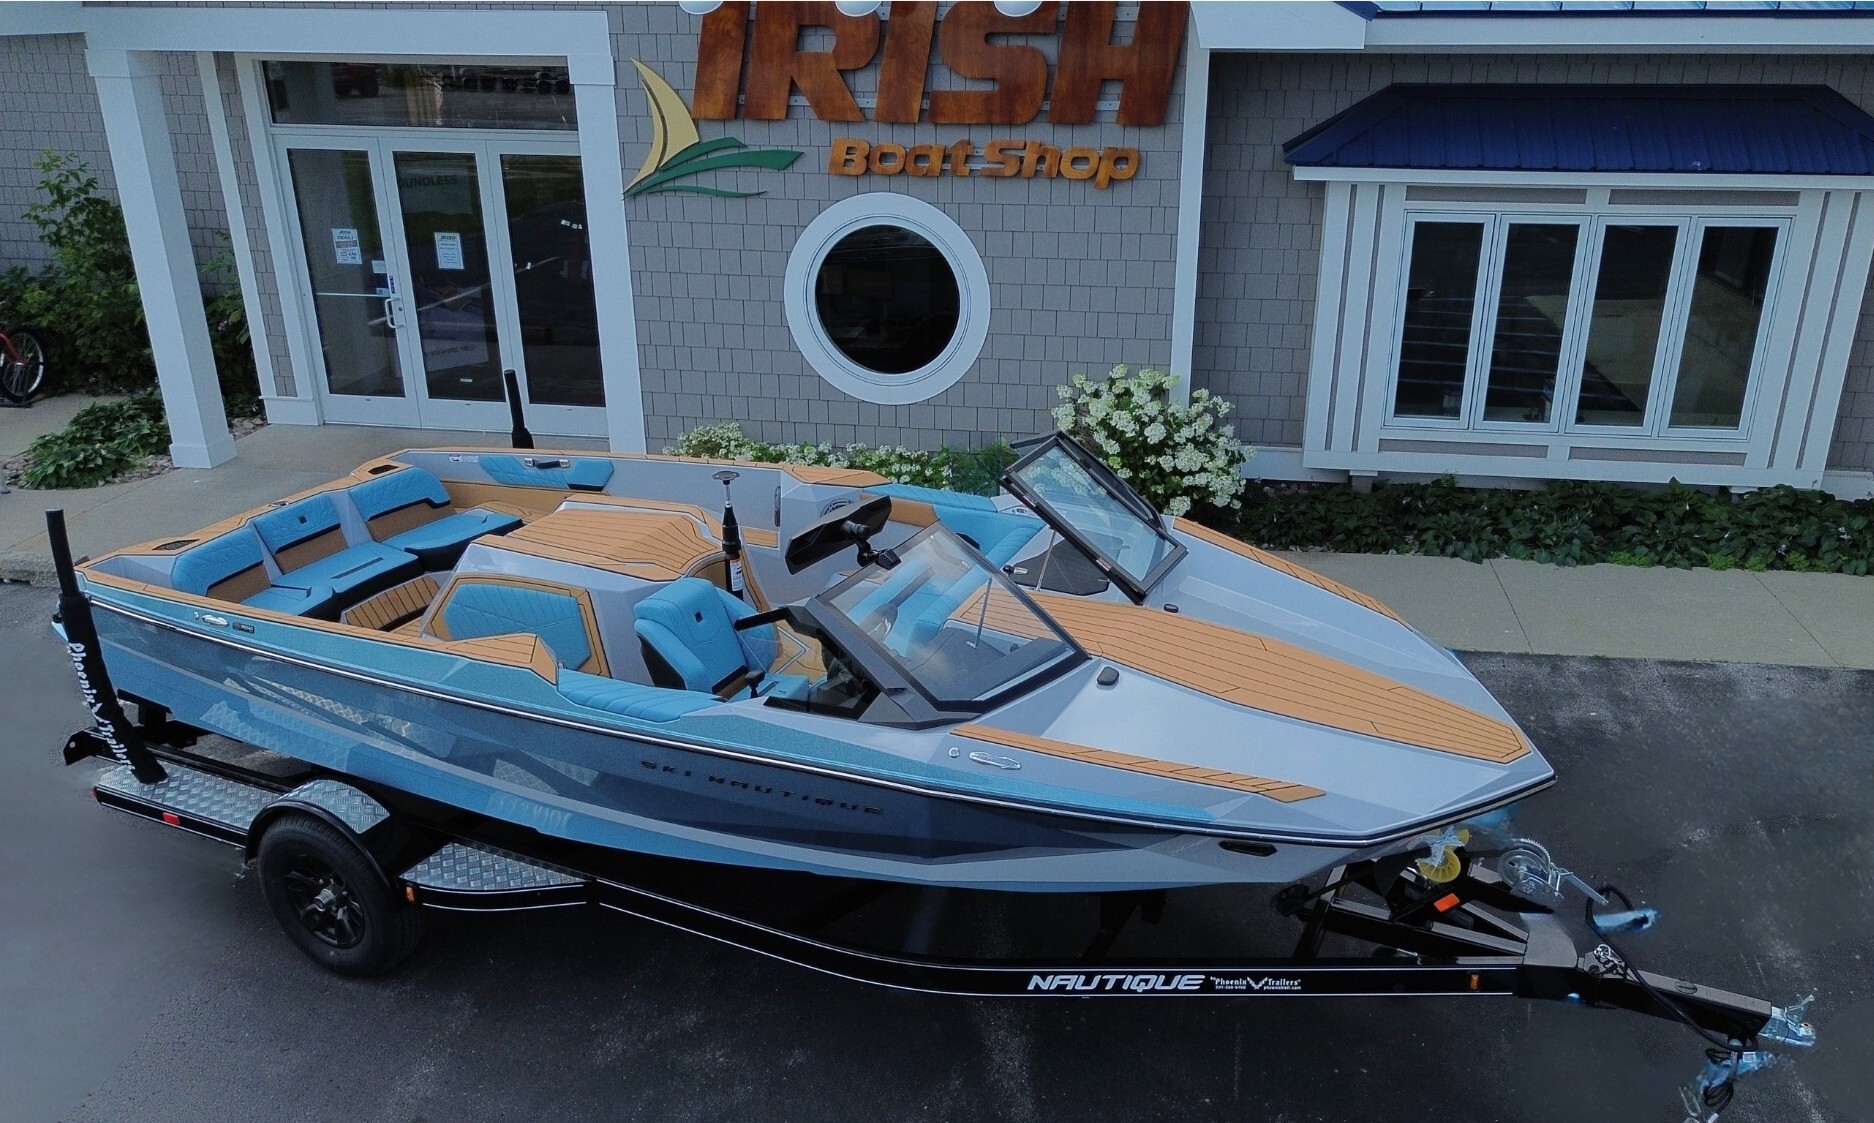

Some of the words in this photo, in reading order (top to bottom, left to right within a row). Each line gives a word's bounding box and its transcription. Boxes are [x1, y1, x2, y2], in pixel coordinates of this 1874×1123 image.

[691, 2, 1190, 126] IRISH
[828, 138, 975, 178] Boat
[980, 139, 1140, 190] Shop
[68, 642, 98, 704] Phoenix
[640, 759, 692, 777] SKI
[708, 774, 884, 816] NAUTIQUE
[1027, 974, 1206, 993] NAUTIQUE
